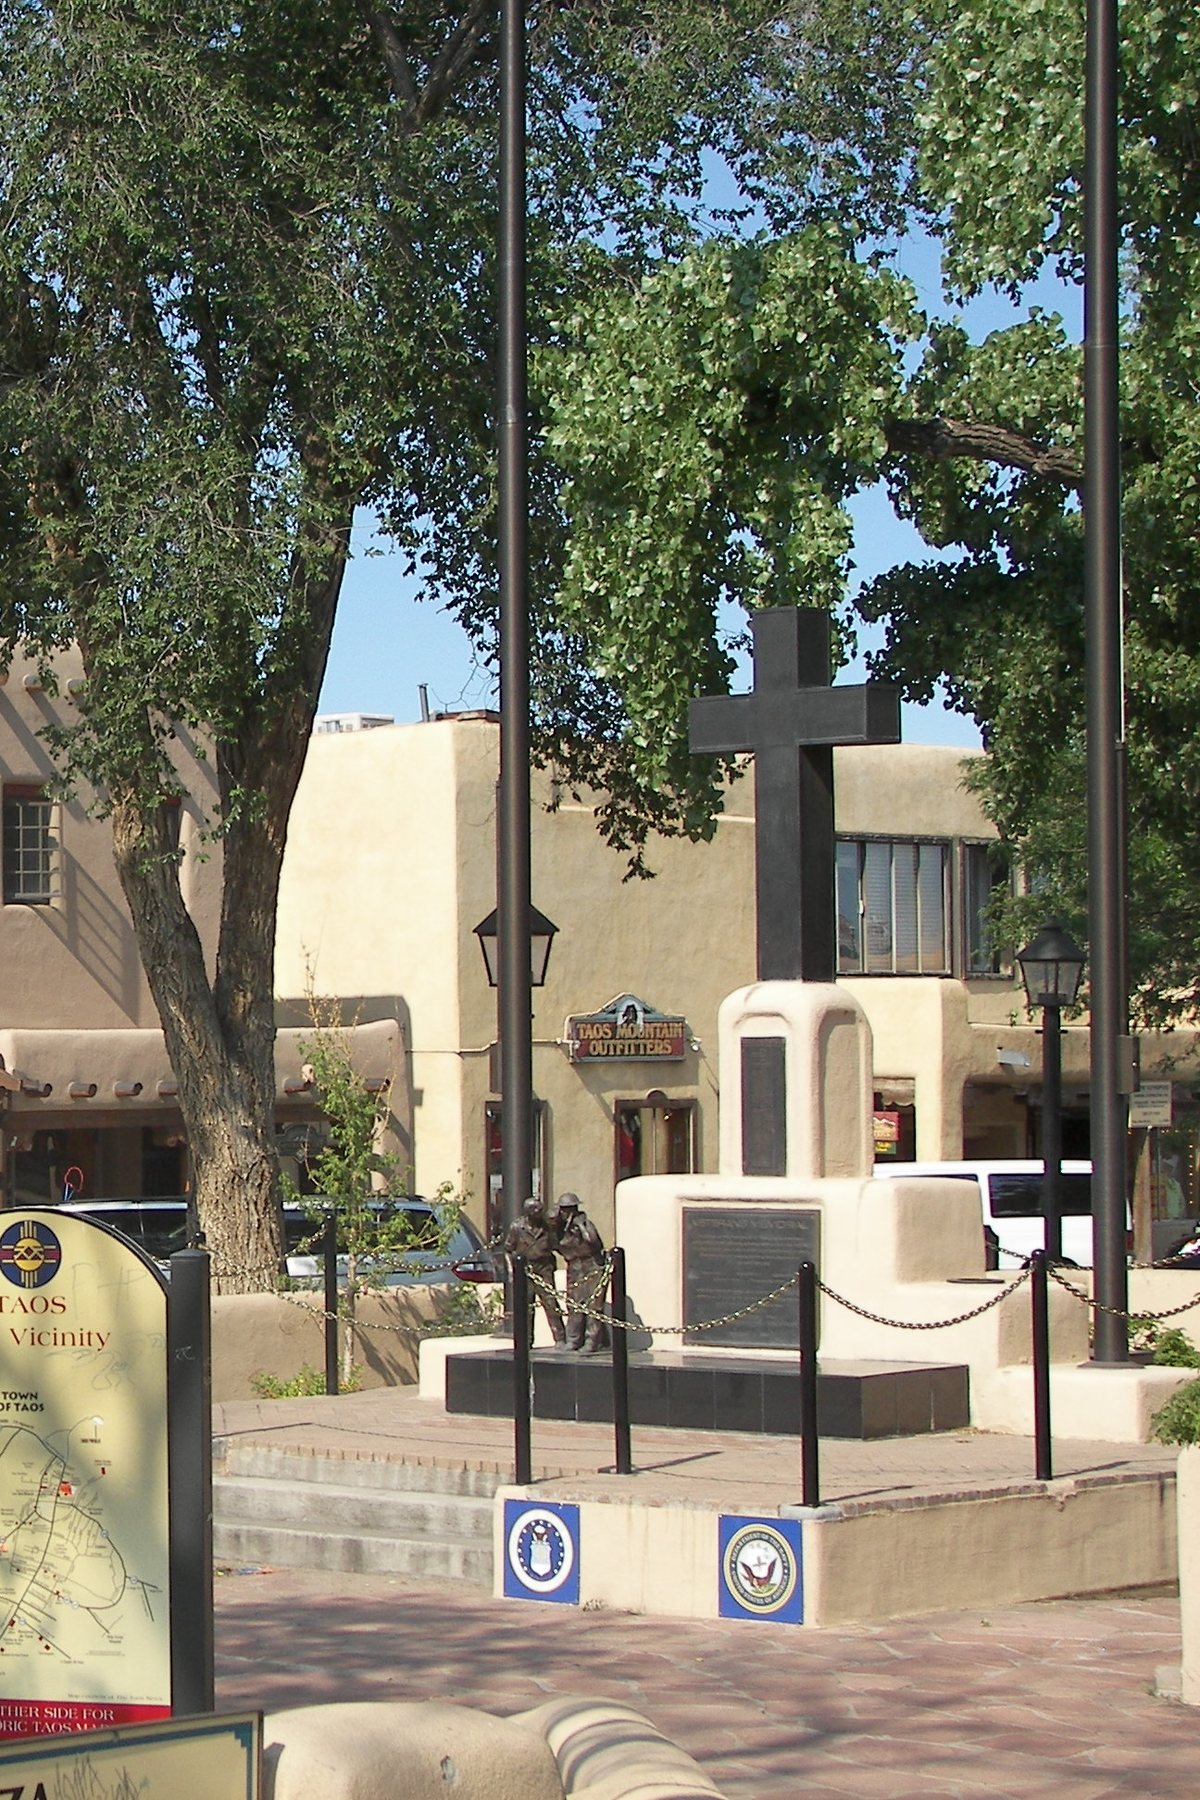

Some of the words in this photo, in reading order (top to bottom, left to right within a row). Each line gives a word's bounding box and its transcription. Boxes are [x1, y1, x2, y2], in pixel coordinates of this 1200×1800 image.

[576, 1023, 612, 1039] TAOS
[616, 1022, 683, 1039] MOUNTAIN
[588, 1039, 672, 1056] OUTFITTERS
[9, 1327, 112, 1351] Vicinity
[1, 1391, 39, 1400] TOWN
[13, 1402, 44, 1412] TAOS
[44, 1707, 78, 1720] SIDE
[83, 1708, 115, 1721] FOR
[32, 1721, 73, 1734] TAOS
